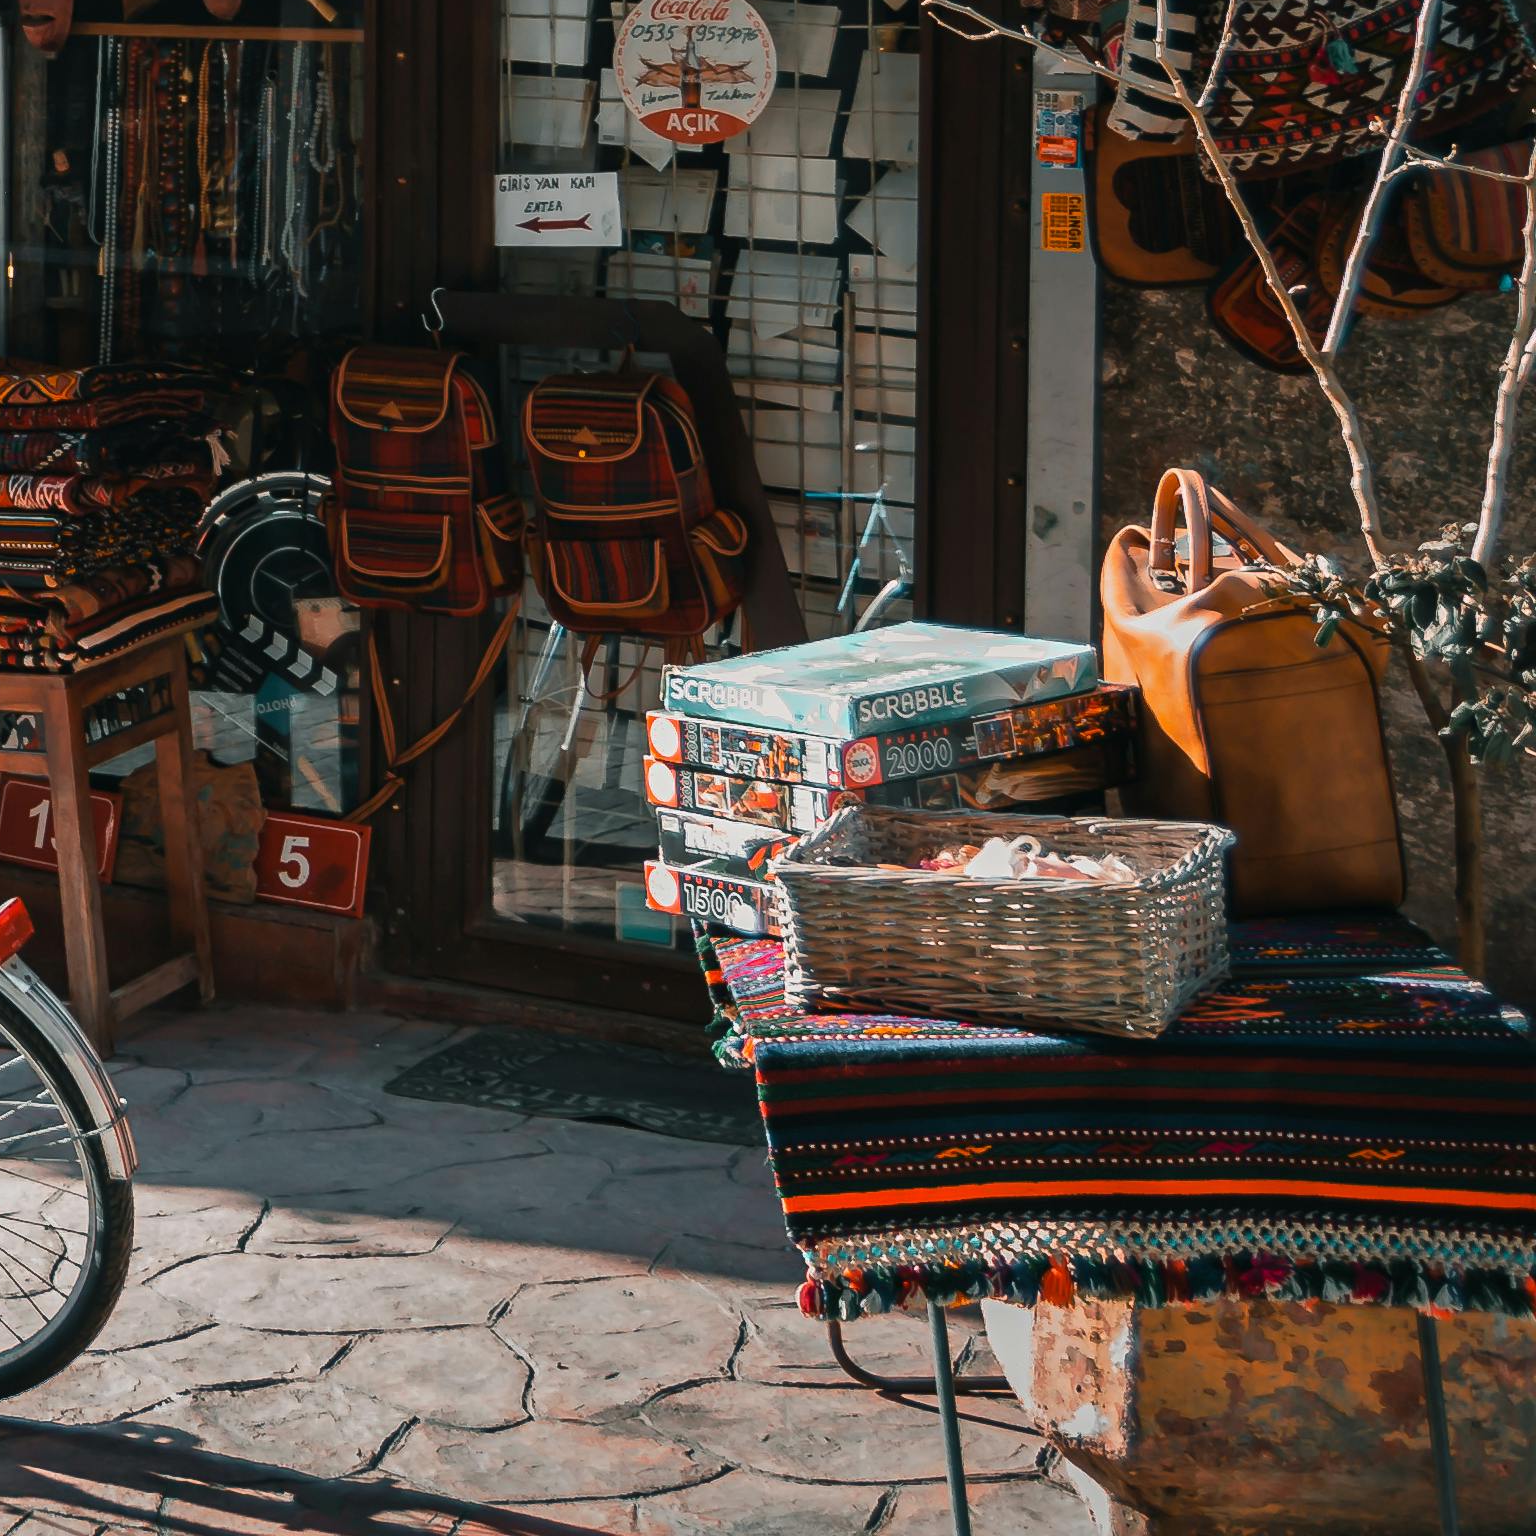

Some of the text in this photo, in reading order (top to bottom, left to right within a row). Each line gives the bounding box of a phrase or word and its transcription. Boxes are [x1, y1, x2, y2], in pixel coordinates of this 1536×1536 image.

[631, 23, 678, 43] 0535
[666, 112, 720, 137] AÇIK
[535, 177, 559, 190] YAN
[571, 175, 595, 190] KAPI
[523, 200, 563, 213] ENTER
[669, 678, 766, 710] SCRABBL
[859, 682, 967, 722] SCRABBLE
[886, 737, 953, 778] 2000
[28, 799, 57, 850] 1
[277, 835, 310, 888] 5
